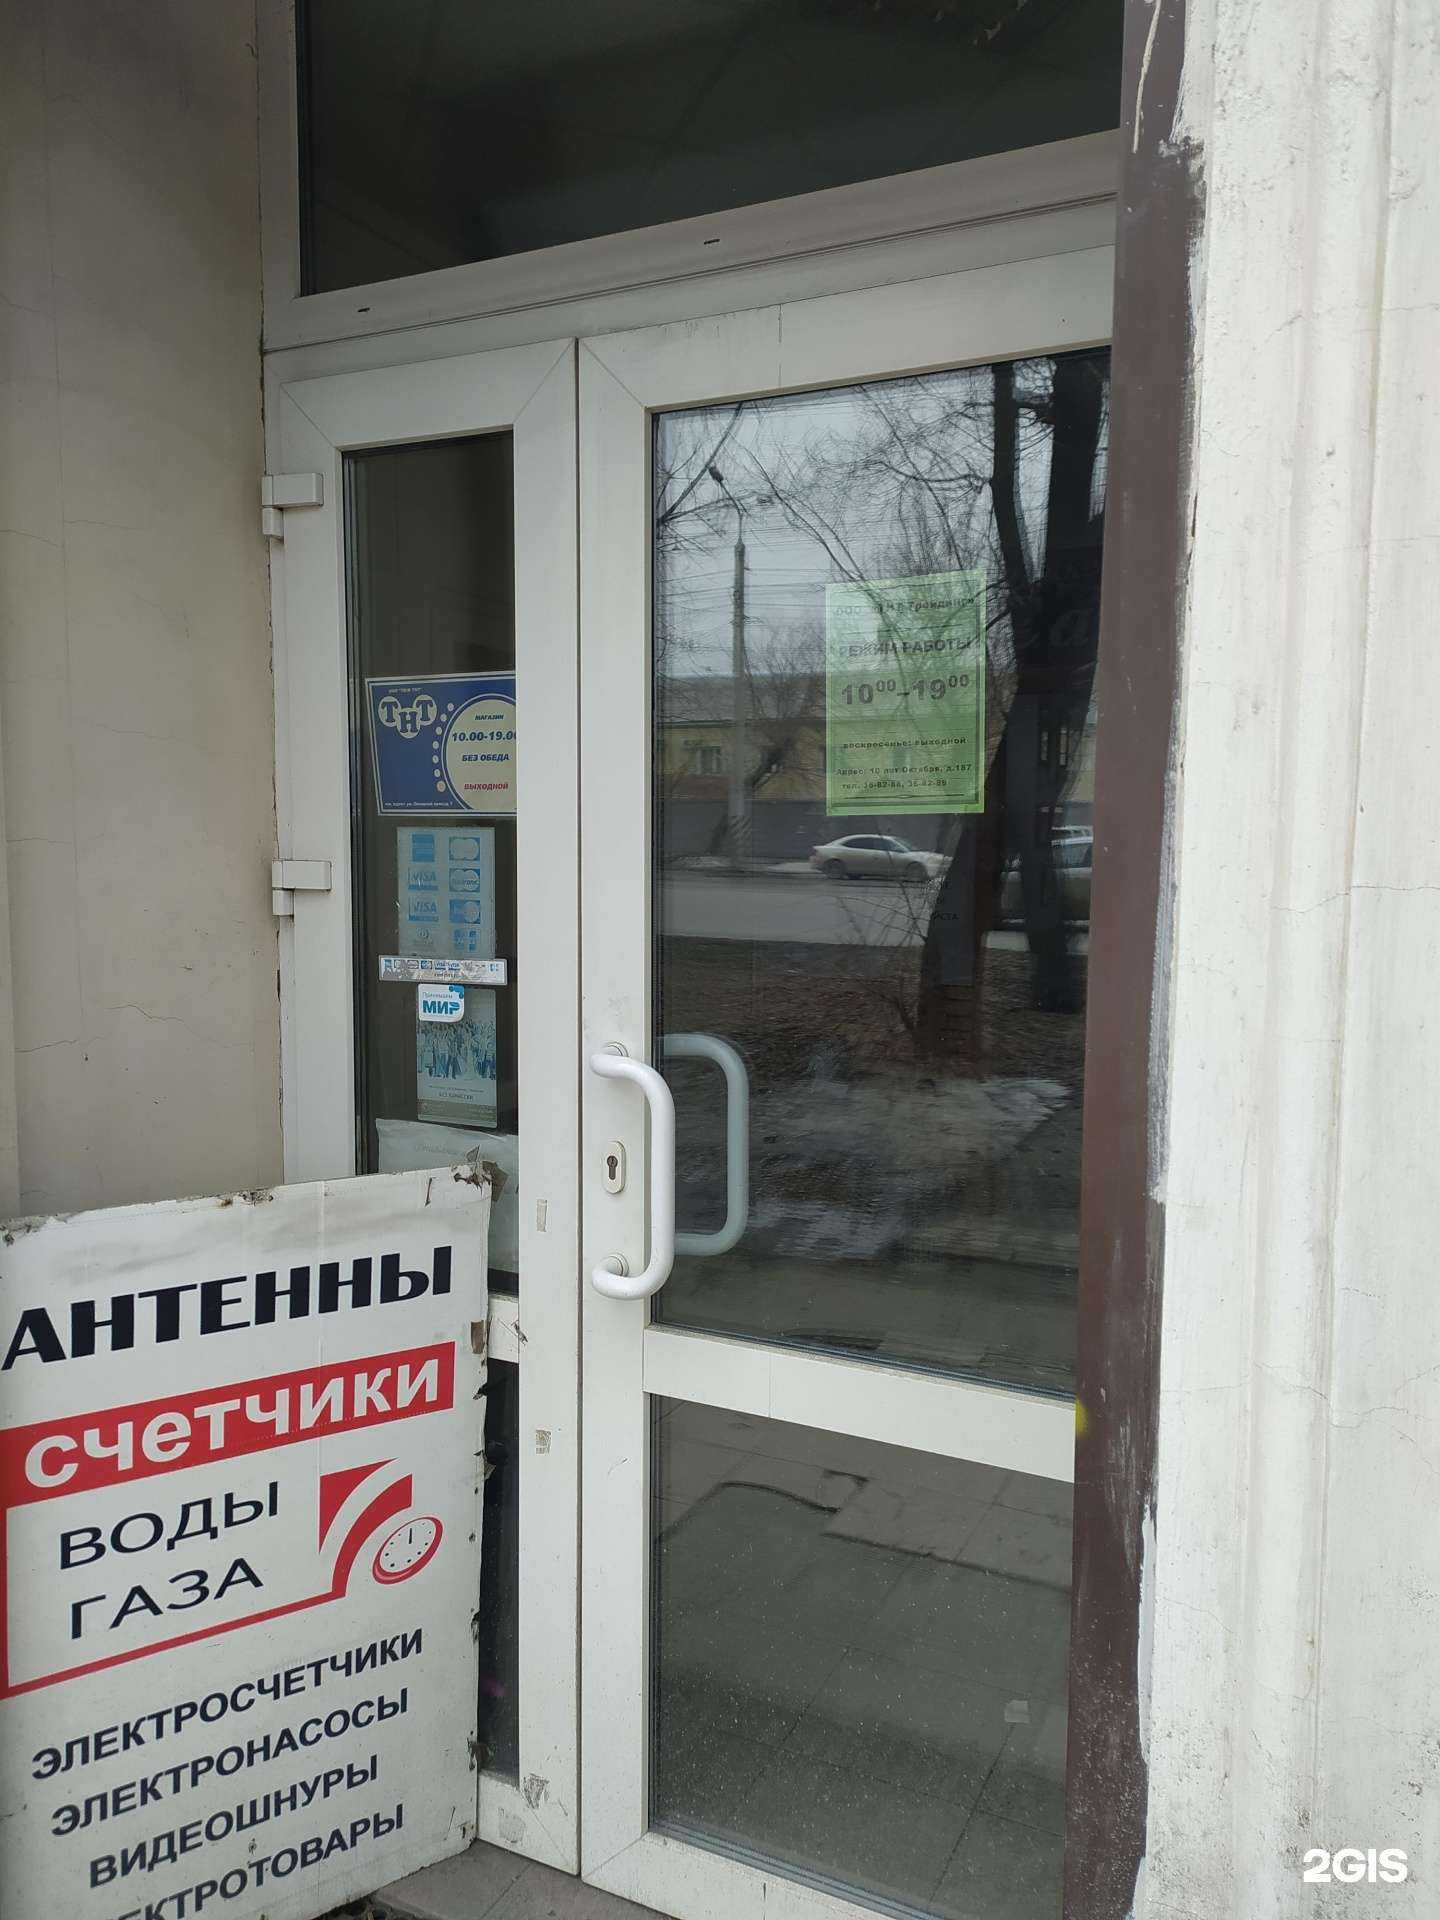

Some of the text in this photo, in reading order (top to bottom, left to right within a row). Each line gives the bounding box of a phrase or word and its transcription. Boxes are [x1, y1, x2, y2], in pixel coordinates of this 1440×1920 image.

[902, 638, 974, 653] РАБОТЫ
[381, 700, 434, 734] ТНТ
[462, 753, 510, 762] БЕЗ ОБЕДА
[464, 783, 509, 792] ВЫХОДНОЙ
[413, 901, 438, 913] VISA
[422, 1000, 460, 1015] МИР
[1, 1245, 452, 1371] АНТЕННЫ
[24, 1358, 440, 1488] счетчики
[60, 1481, 279, 1570] ВОДЫ
[71, 1558, 264, 1639] ГАЗА
[32, 1628, 423, 1781] ЭЛЕКТРОСЧЕТЧИКИ
[51, 1687, 408, 1837] ЭЛЕКТРОНАСОСЫ
[89, 1754, 378, 1889] ВИДЕОШНУРЫ
